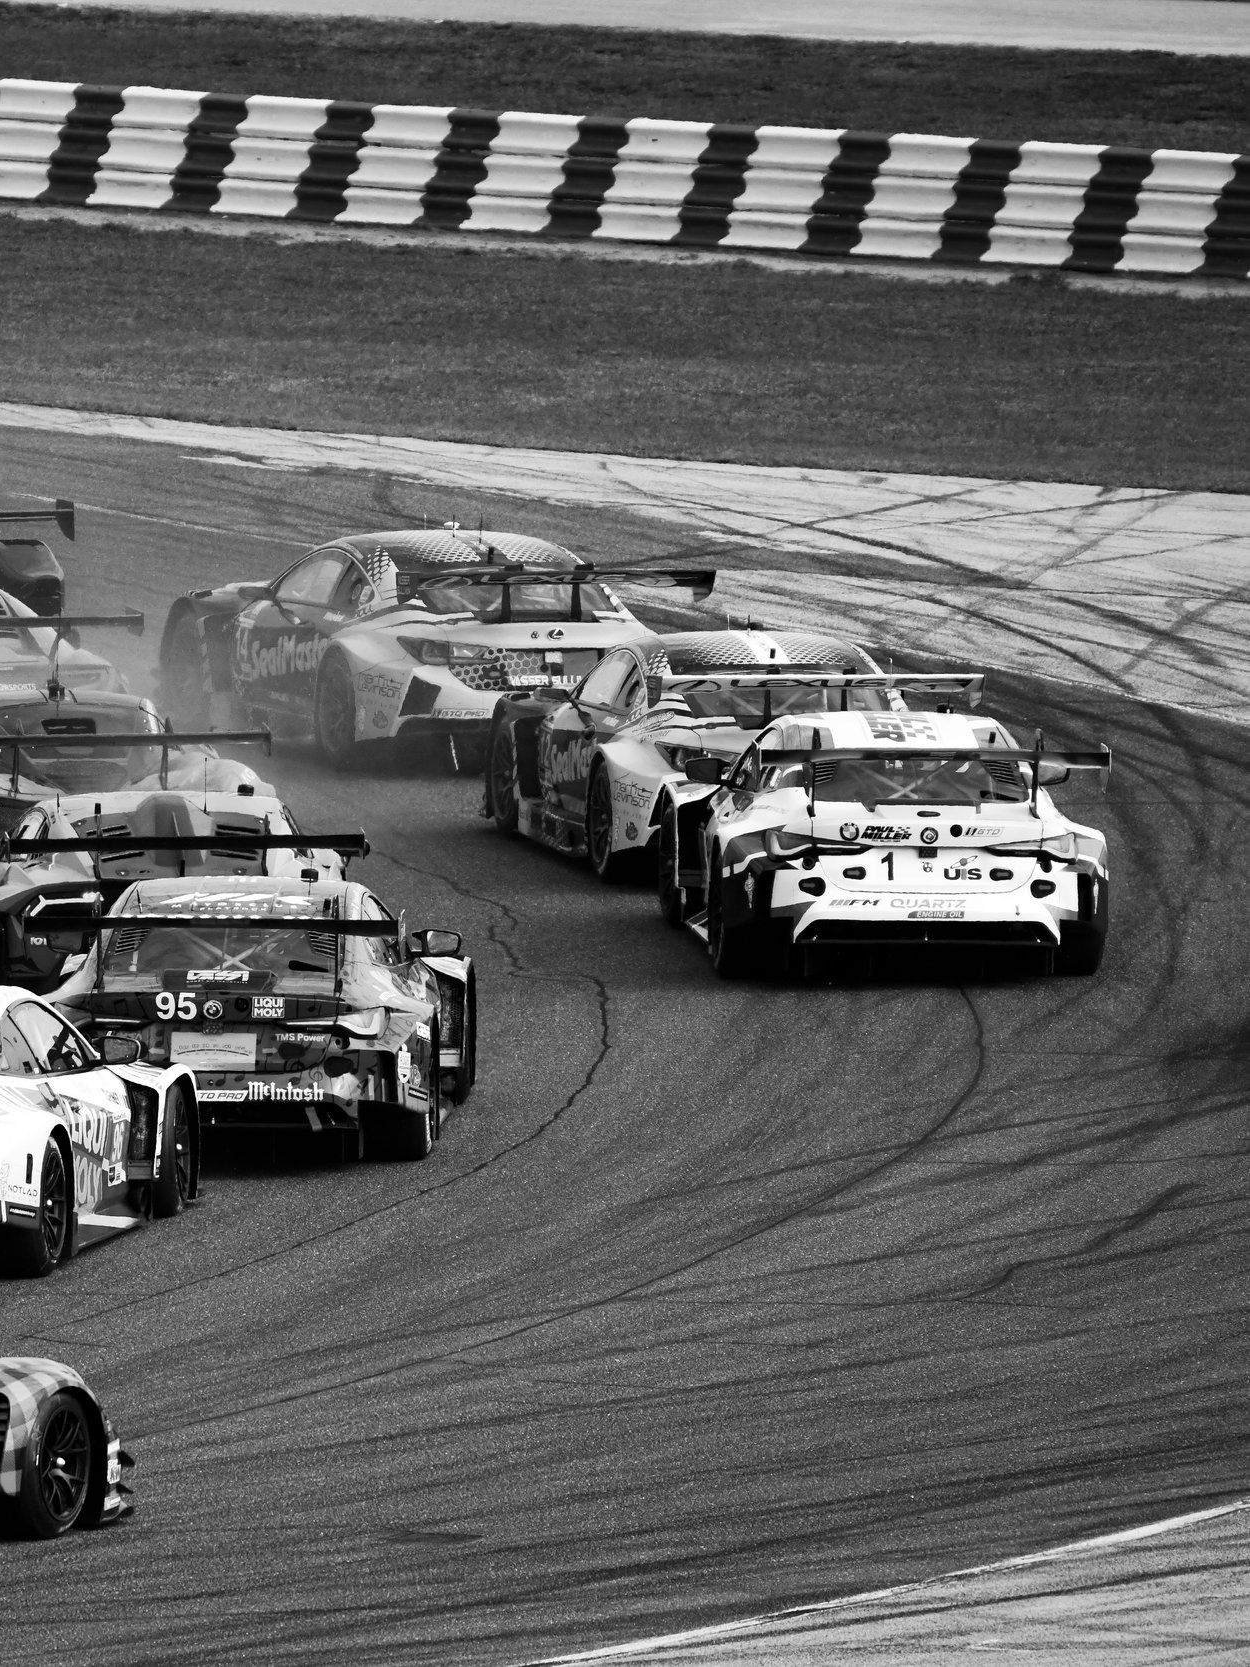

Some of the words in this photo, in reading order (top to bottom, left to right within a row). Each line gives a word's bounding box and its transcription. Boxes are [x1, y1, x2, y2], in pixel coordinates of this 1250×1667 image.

[480, 573, 626, 583] LEXUS
[510, 674, 549, 686] VASSER
[730, 679, 887, 687] LEXUS
[865, 825, 895, 833] PAUL
[860, 832, 912, 840] MILLER
[881, 852, 894, 881] 1
[890, 898, 966, 908] QUARTZ
[155, 992, 198, 1021] 95
[254, 997, 284, 1008] LIQUI
[253, 1007, 285, 1018] MOLY
[275, 1033, 295, 1041] TMS
[297, 1033, 325, 1042] Power
[217, 1092, 244, 1100] PRO
[248, 1081, 325, 1102] McIntosh
[111, 1122, 126, 1163] 96
[7, 1185, 38, 1197] NOTLAD
